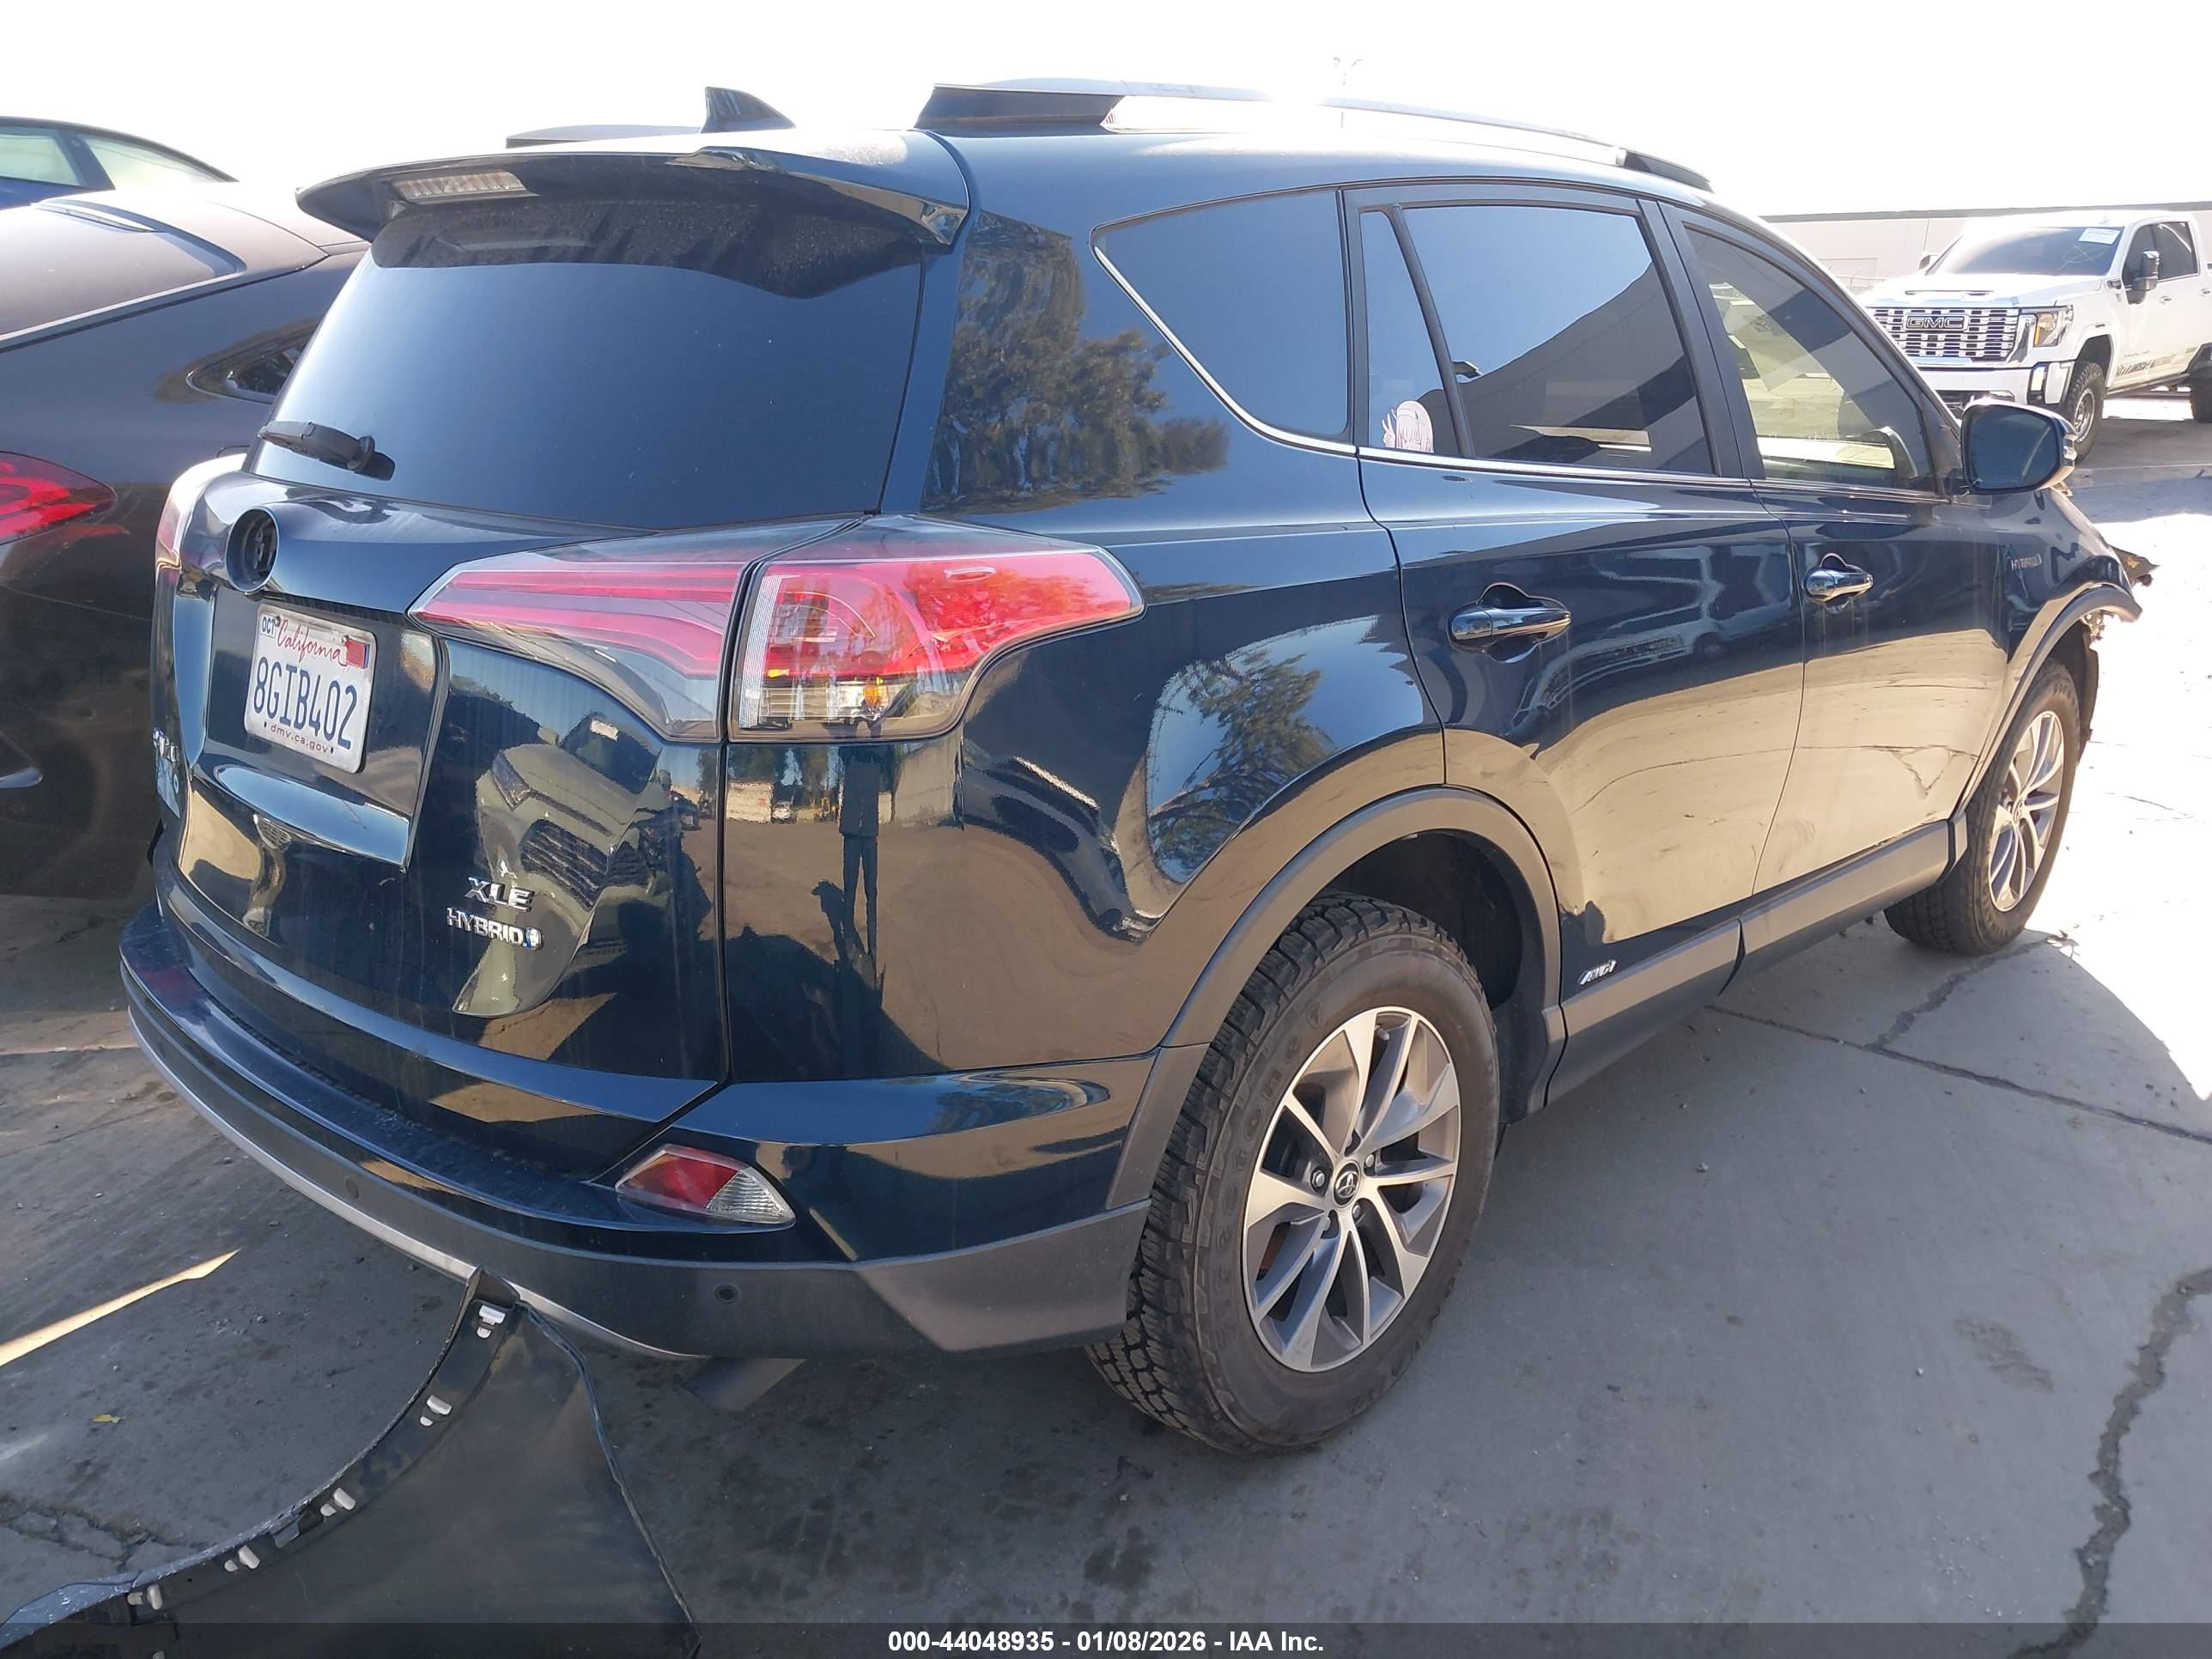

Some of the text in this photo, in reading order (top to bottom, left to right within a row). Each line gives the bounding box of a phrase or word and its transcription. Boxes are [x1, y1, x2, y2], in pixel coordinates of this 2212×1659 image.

[1907, 317, 1965, 329] GMC
[261, 616, 276, 635] OCT
[276, 618, 348, 666] California
[253, 656, 357, 750] 8GIB402
[270, 722, 330, 754] dmv.ca.gov
[464, 876, 535, 913] XLE
[446, 907, 524, 947] HYBRID
